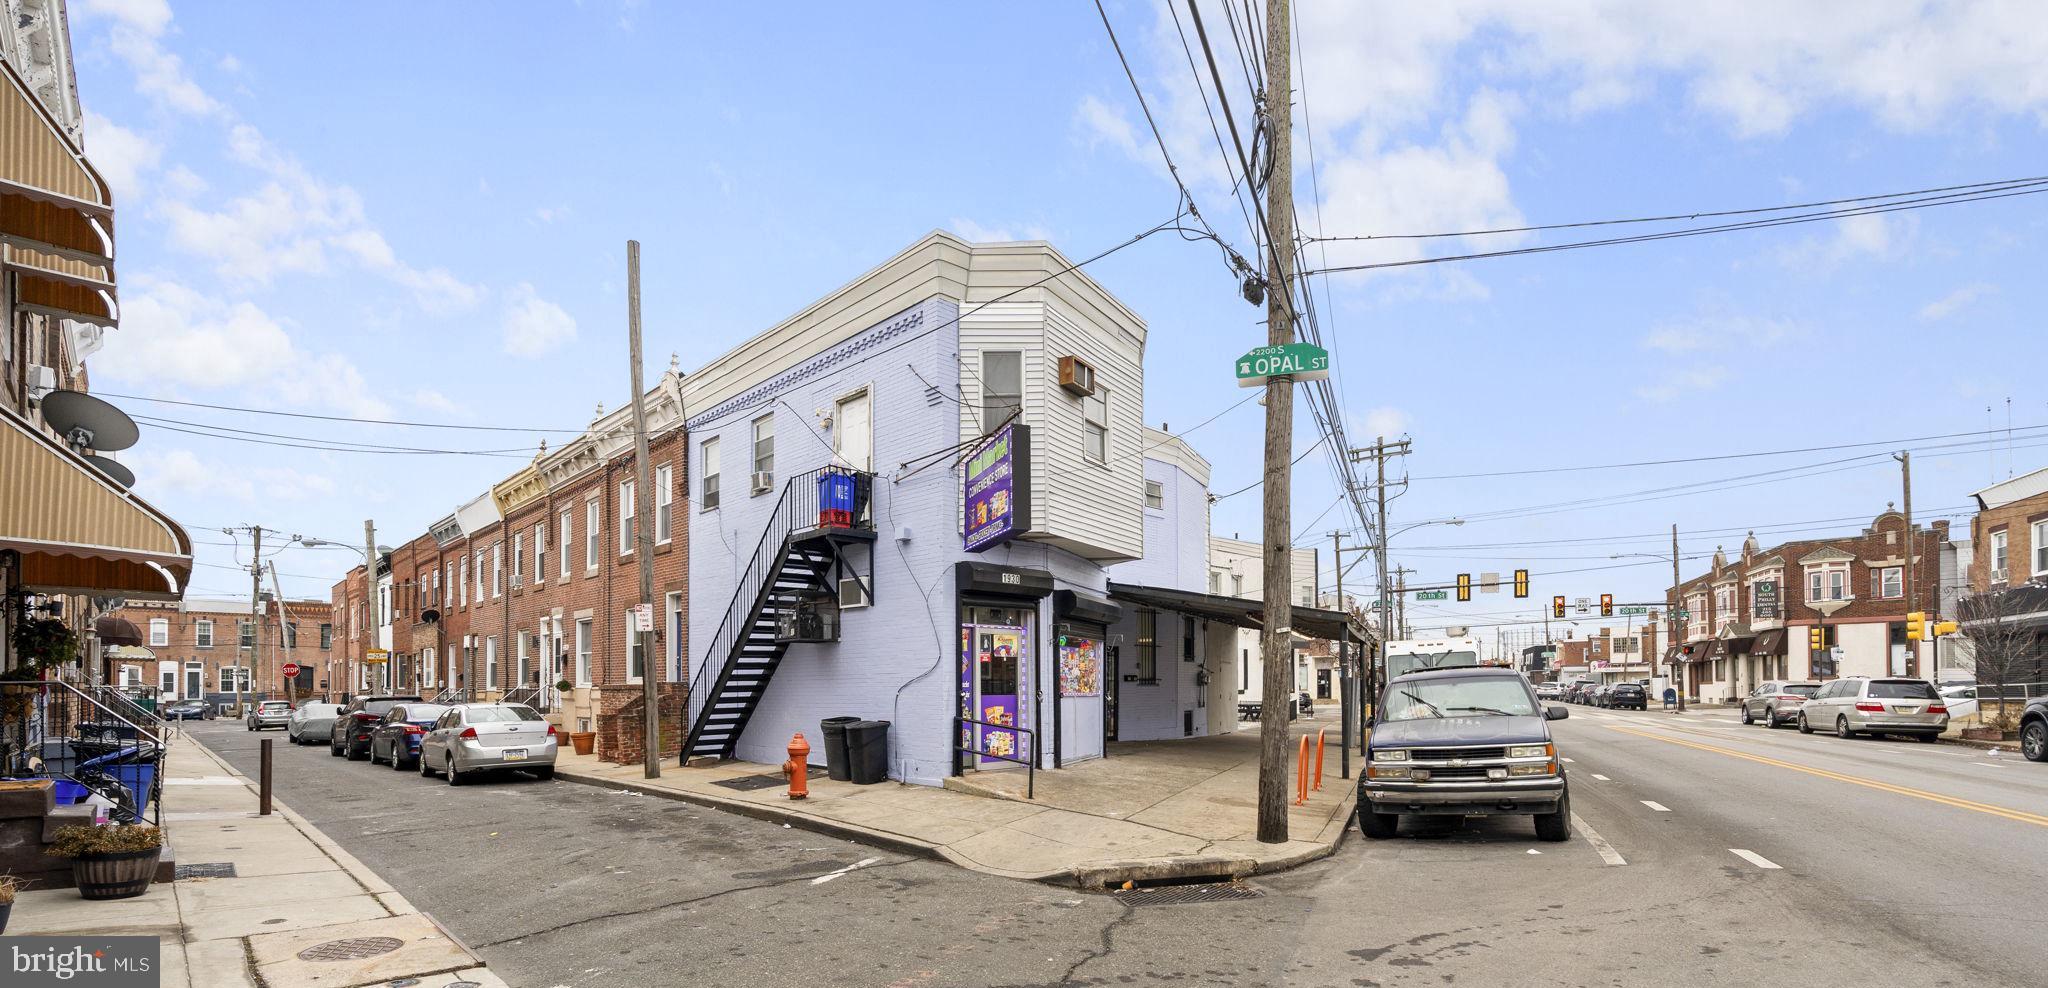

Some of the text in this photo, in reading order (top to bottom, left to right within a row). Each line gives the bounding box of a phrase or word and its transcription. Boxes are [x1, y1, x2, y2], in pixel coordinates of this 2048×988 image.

[1256, 345, 1285, 356] 2200 S
[1255, 355, 1327, 375] OPAL ST
